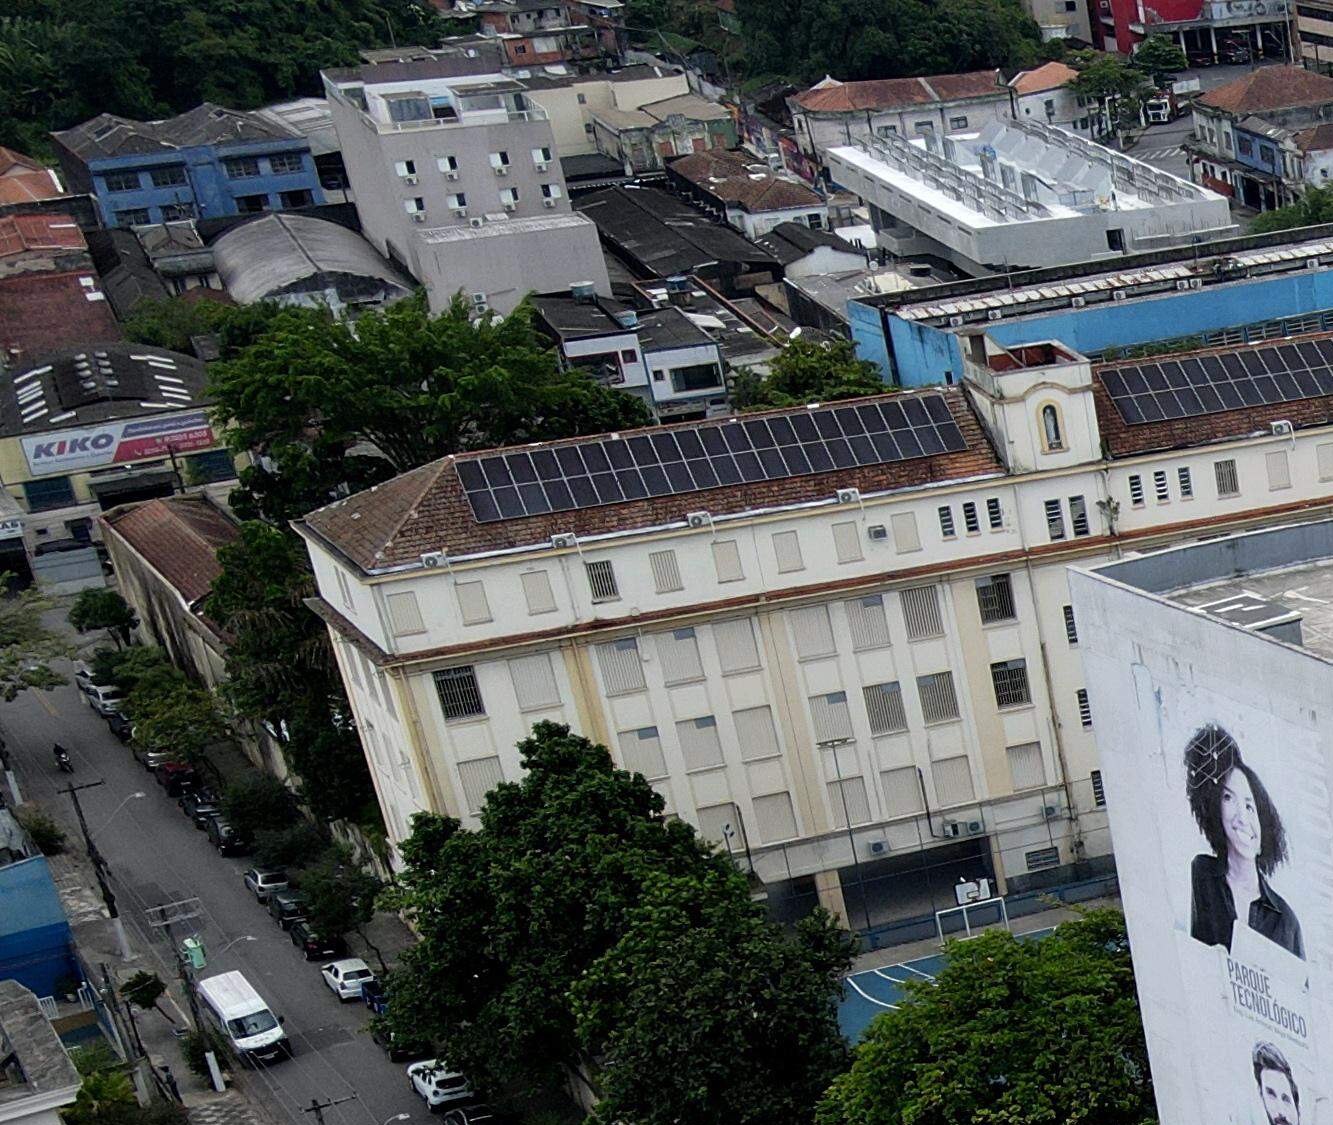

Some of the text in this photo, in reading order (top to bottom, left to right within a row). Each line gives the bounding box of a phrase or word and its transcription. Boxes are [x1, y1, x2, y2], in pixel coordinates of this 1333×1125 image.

[33, 433, 114, 459] KIKO
[1227, 958, 1272, 998] PARQUE
[1230, 980, 1307, 1038] TECNOLÓGICO
